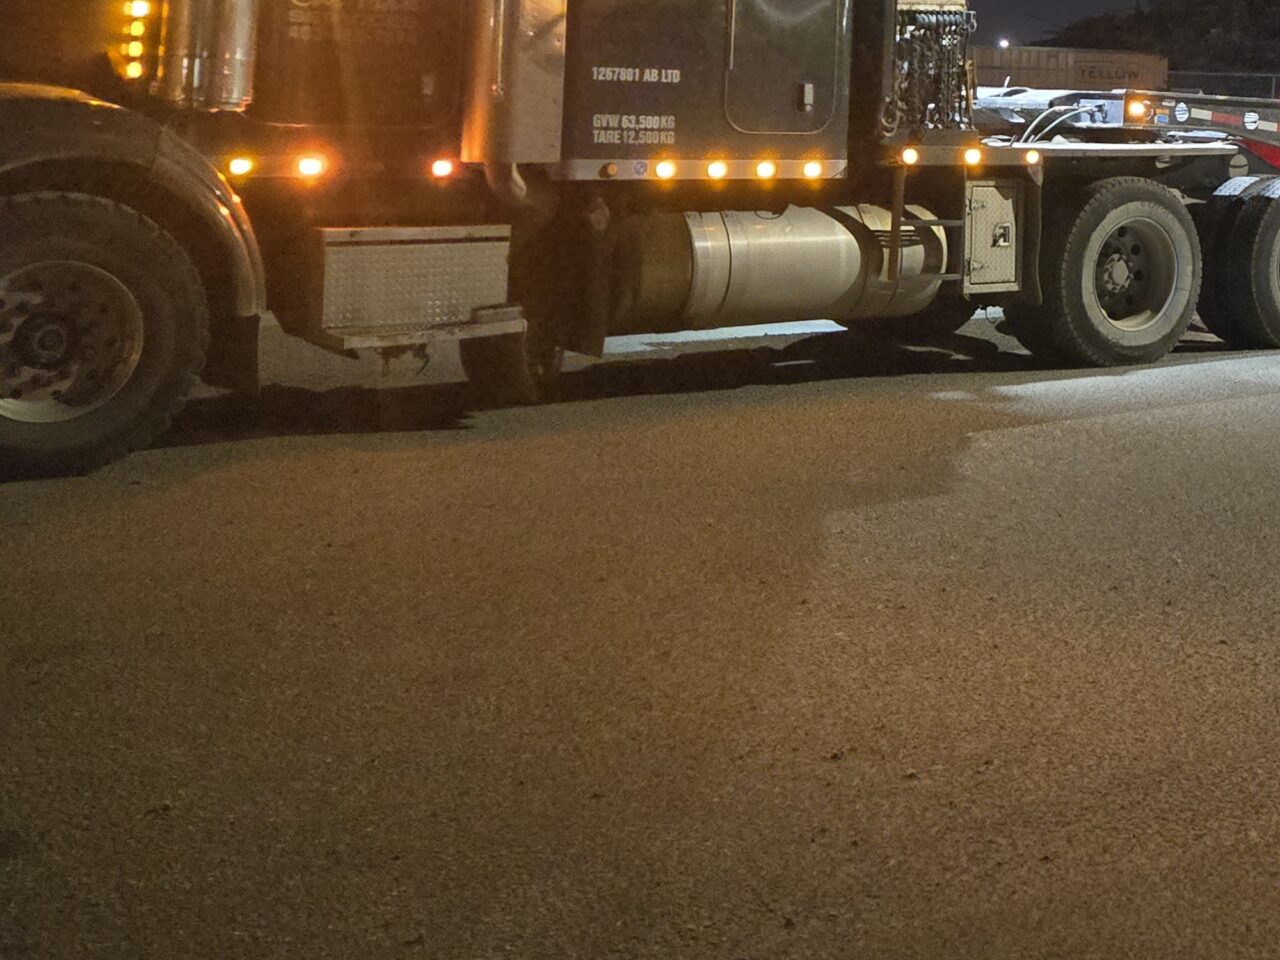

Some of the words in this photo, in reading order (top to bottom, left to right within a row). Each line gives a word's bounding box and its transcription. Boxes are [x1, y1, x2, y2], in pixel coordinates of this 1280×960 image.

[643, 68, 659, 82] AB
[661, 69, 681, 83] LTD
[593, 114, 620, 128] GVW
[593, 130, 621, 144] TARE
